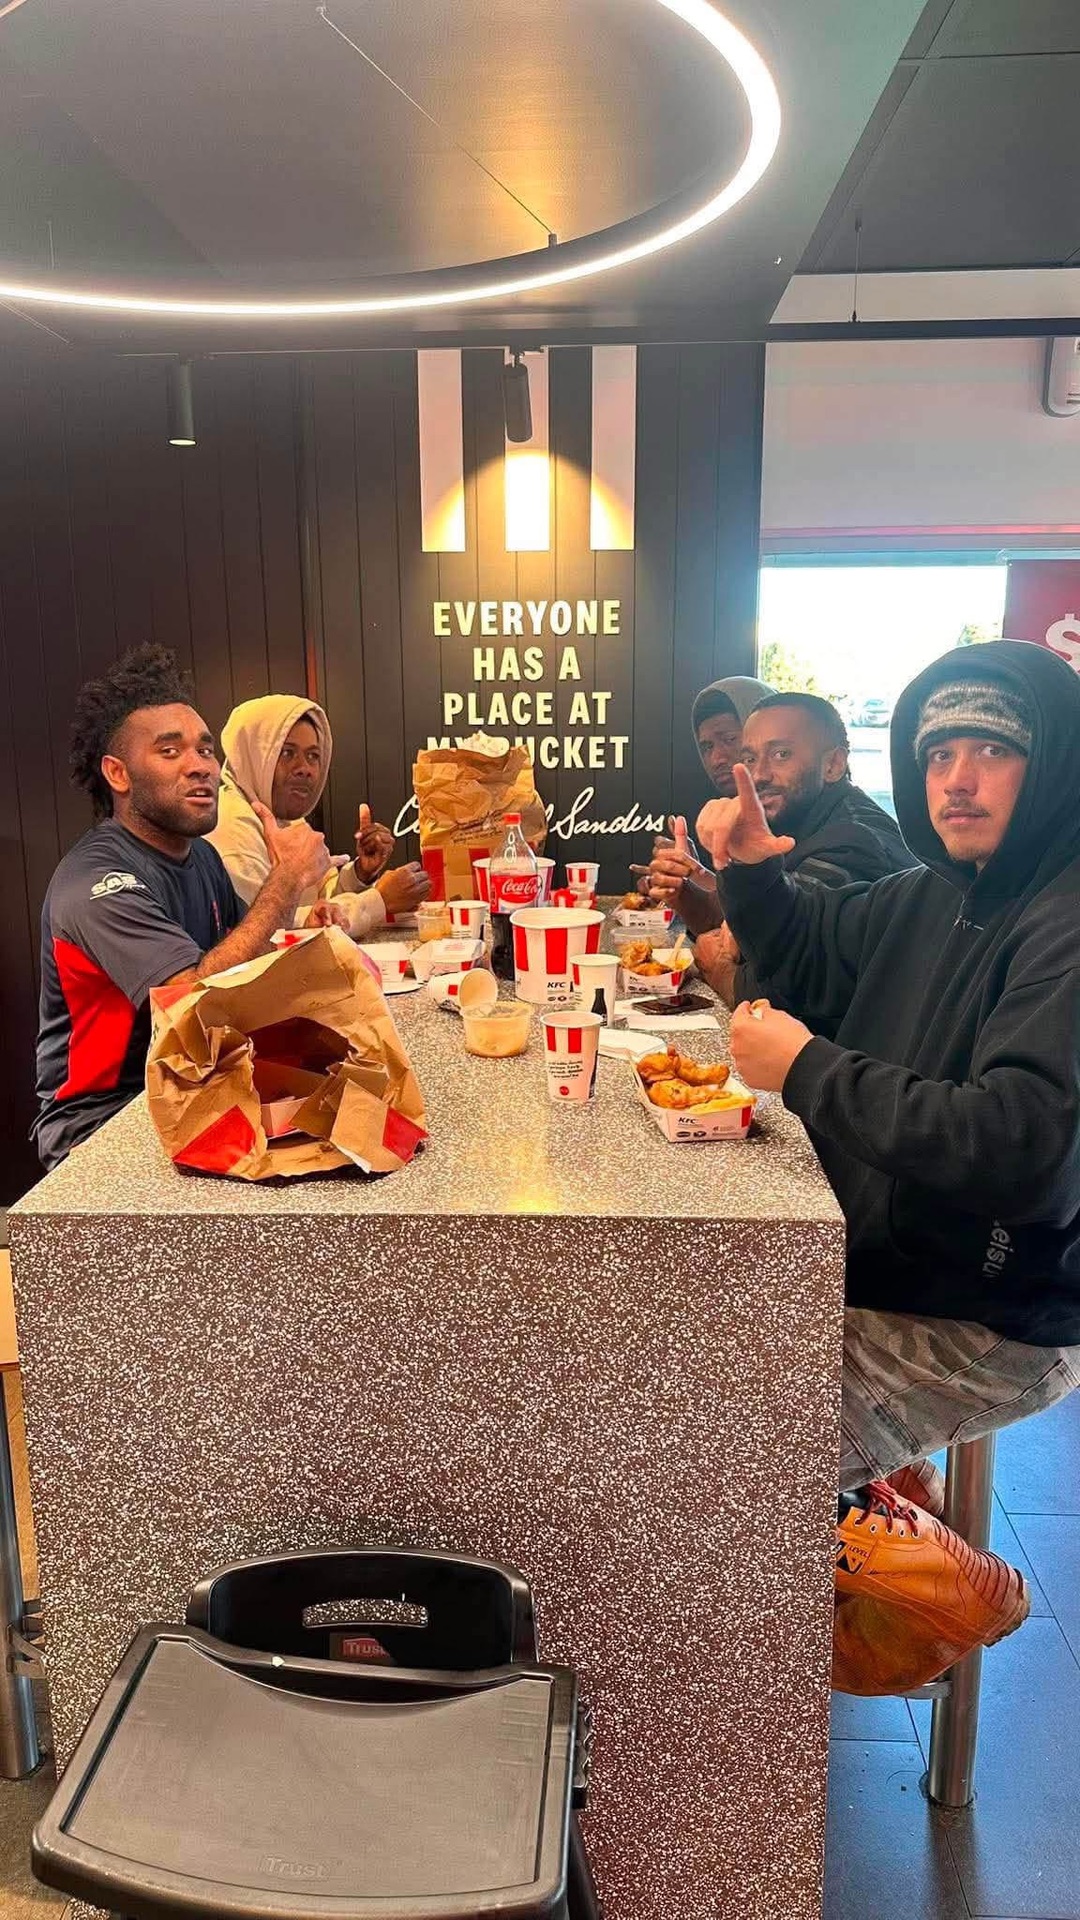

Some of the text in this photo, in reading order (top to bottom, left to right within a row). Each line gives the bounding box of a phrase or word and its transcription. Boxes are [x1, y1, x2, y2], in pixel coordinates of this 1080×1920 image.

[432, 599, 621, 636] EVERYONE
[473, 646, 581, 681] HAS A
[443, 691, 612, 726] PLACE AT
[501, 735, 629, 769] UCKET
[549, 786, 664, 840] Sanders
[547, 981, 566, 989] KFC
